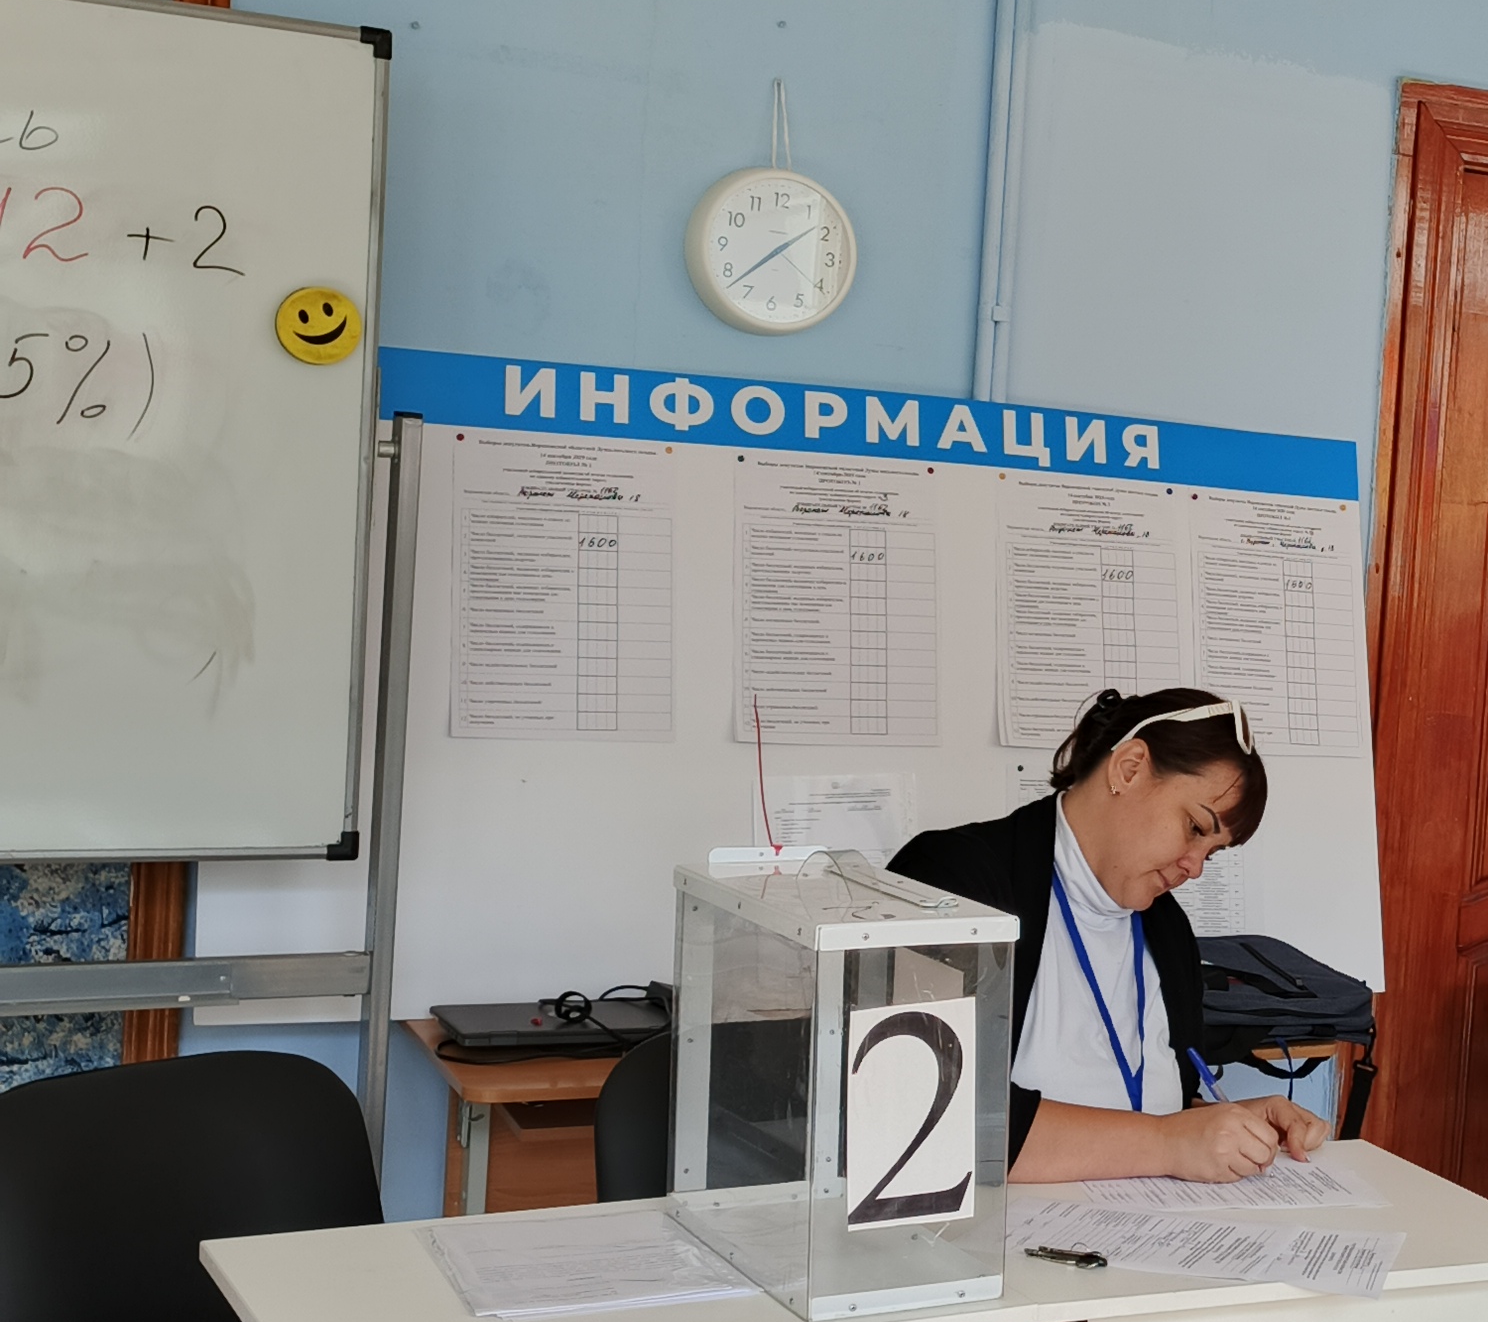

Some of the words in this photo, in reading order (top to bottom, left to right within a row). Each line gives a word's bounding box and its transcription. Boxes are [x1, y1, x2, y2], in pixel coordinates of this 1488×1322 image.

[750, 195, 761, 211] 11
[774, 192, 790, 209] 12
[728, 211, 745, 228] 10
[805, 204, 812, 220] 1
[820, 226, 830, 242] 2
[718, 236, 728, 251] 9
[825, 252, 835, 267] 3
[723, 262, 733, 277] 8
[743, 285, 754, 299] 7
[813, 278, 825, 295] 4
[766, 296, 776, 311] 6
[793, 293, 804, 308] 5
[504, 364, 1160, 469] ИНФОРМАЦИЯ
[579, 537, 617, 548] 1600
[850, 551, 885, 562] 1600
[1101, 569, 1134, 581] 1600
[848, 1010, 973, 1225] 2
